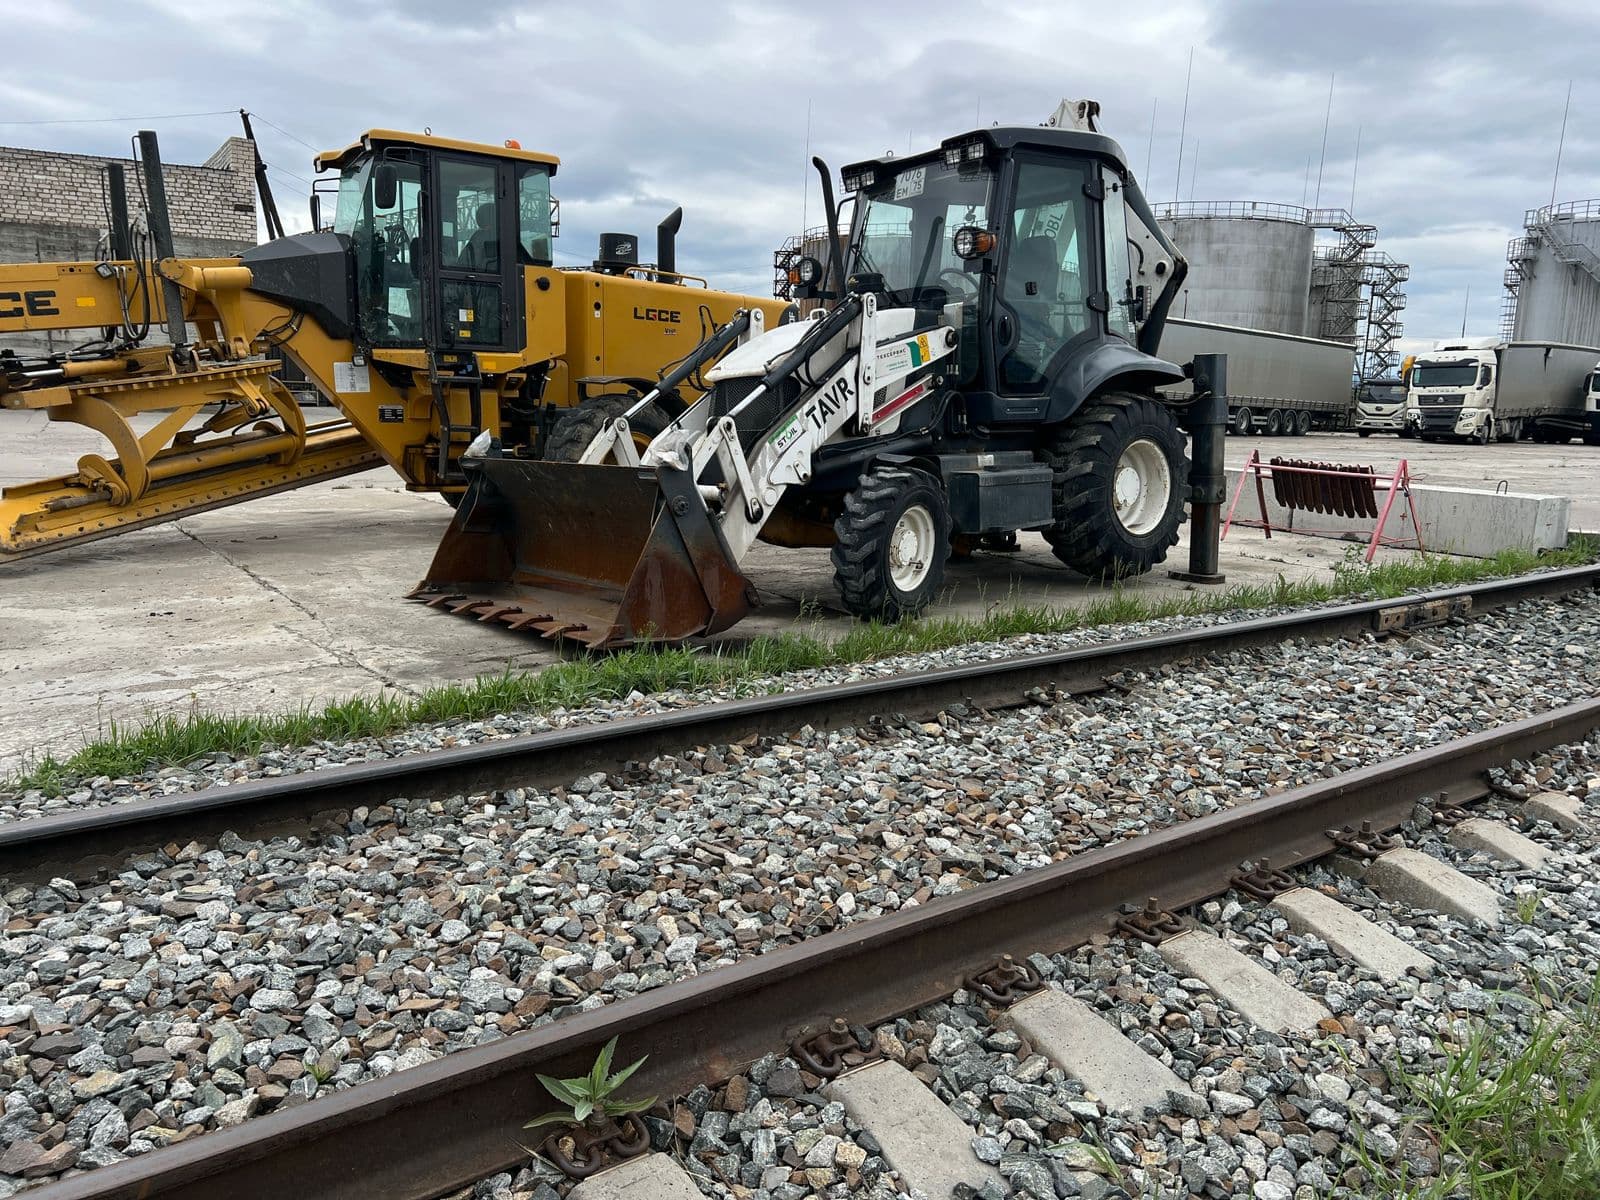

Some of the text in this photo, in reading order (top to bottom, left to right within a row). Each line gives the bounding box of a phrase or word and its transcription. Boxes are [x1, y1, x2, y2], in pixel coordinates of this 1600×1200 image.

[912, 181, 922, 191] 75
[633, 307, 681, 323] LGCE
[805, 377, 855, 429] TAVR
